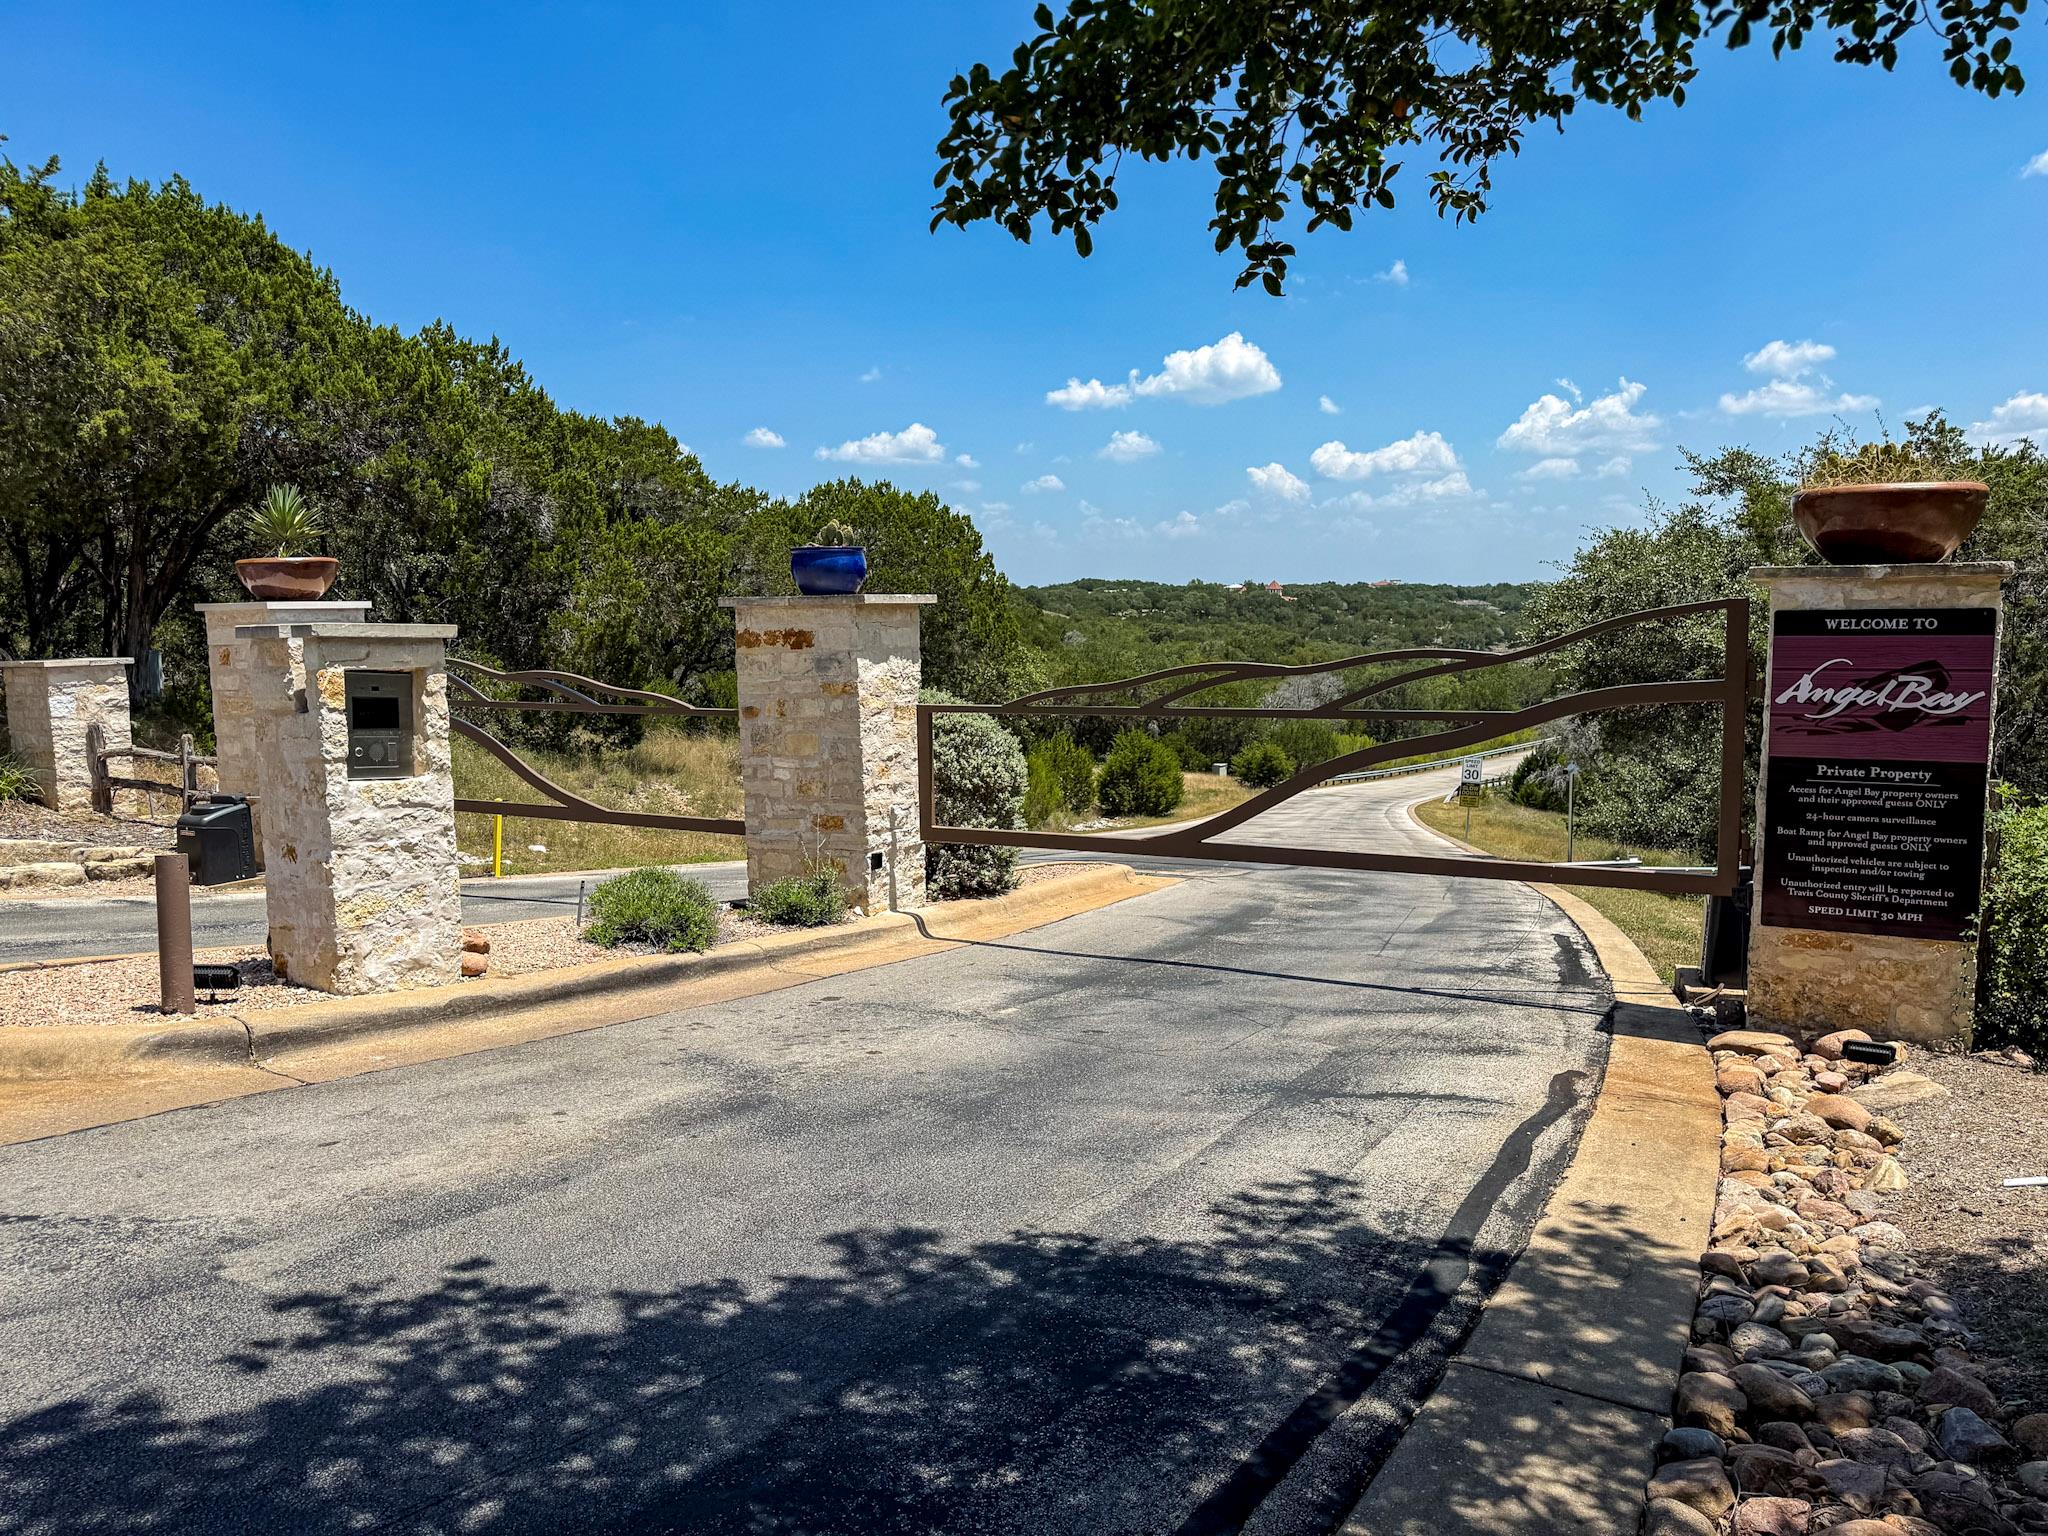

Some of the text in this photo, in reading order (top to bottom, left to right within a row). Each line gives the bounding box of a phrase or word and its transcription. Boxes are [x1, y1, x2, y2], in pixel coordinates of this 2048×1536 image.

[1825, 618, 1938, 630] WELCOME TO
[1775, 658, 1986, 719] Angel Bay
[1464, 770, 1479, 780] 30
[1817, 765, 1932, 783] Private Property
[1788, 785, 1817, 793] Access
[1819, 786, 1833, 794] for
[1834, 787, 1862, 797] Angel
[1864, 788, 1880, 798] Bay
[1882, 791, 1923, 800] property
[1798, 795, 1947, 808] and their approved guests ONLY
[1806, 812, 1936, 825] 24-hour camera surveillance
[1777, 826, 1967, 845] Boat Ramp for Angel Bay property owners
[1808, 838, 1932, 852] and approved guests ONLY
[1787, 853, 1848, 865] Unauthorized
[1850, 857, 1886, 867] vehicles
[1904, 861, 1937, 871] subject
[1811, 864, 1925, 880] inspection and/or towing
[1780, 878, 1954, 898] Unauthorized entry will be reported to
[1787, 887, 1948, 907] Travis County Sheriff's Department
[1808, 905, 1923, 922] SPEED LIMIT 30 MPH
